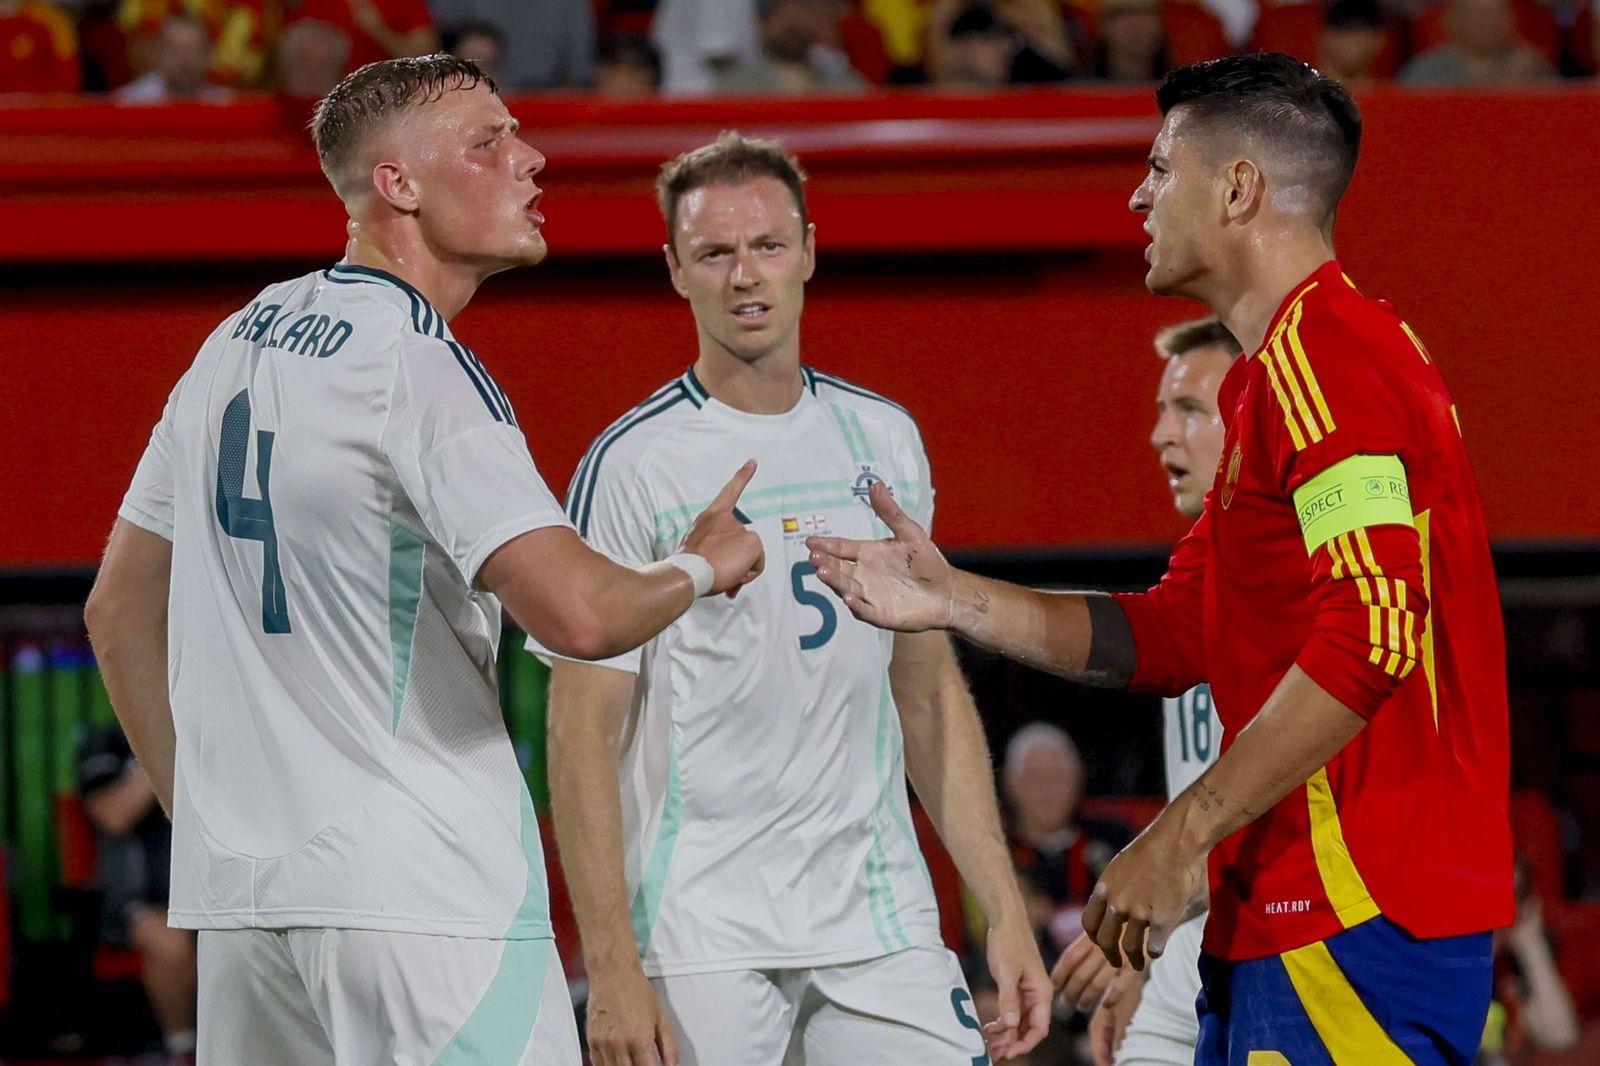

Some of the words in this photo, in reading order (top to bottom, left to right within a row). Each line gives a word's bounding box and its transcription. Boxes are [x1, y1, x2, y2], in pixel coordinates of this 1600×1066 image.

[231, 301, 353, 358] BALARD
[215, 387, 292, 634] 4
[1299, 488, 1344, 526] ESPECT
[790, 560, 837, 650] 5
[1178, 683, 1211, 762] 18
[1265, 899, 1311, 915] HEAT.RDY
